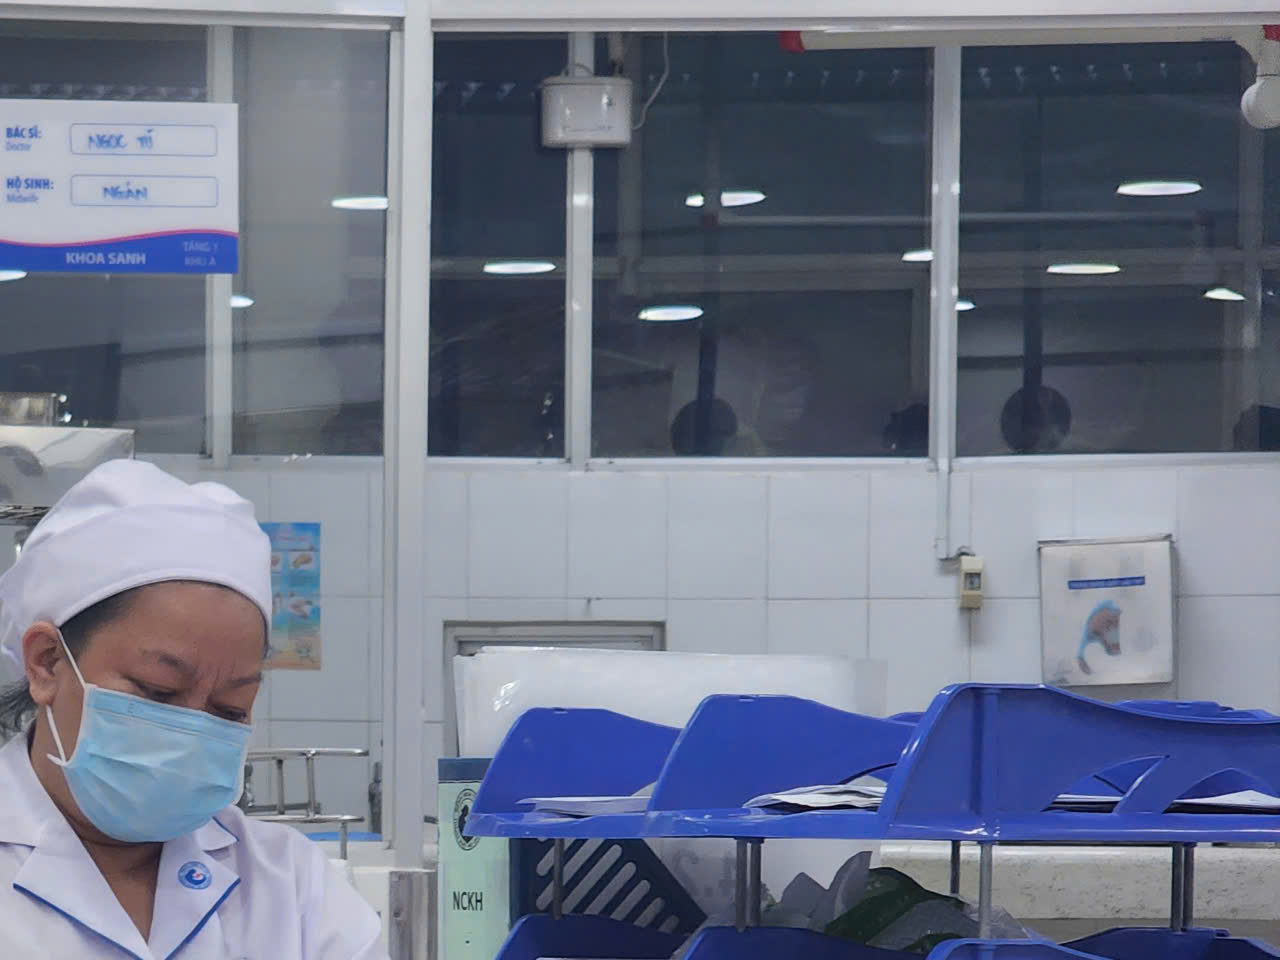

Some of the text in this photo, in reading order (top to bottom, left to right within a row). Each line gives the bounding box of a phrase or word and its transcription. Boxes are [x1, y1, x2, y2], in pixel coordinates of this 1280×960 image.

[65, 251, 147, 265] KHOA SANH
[453, 891, 483, 912] NCKH
